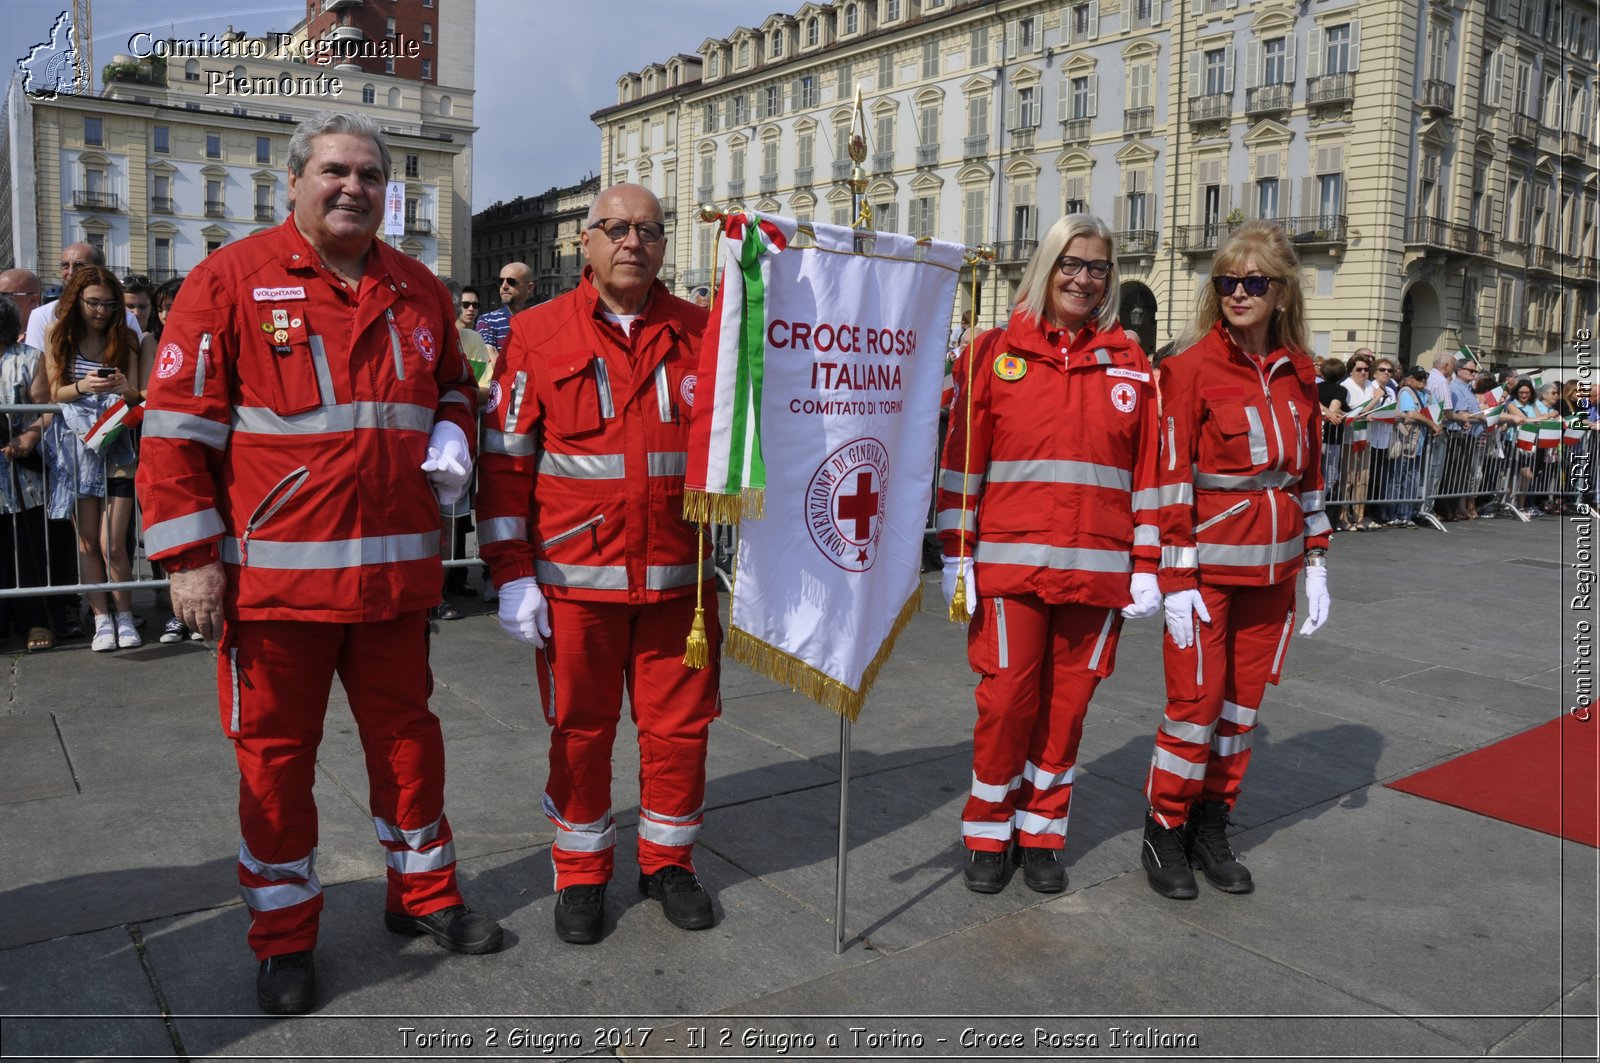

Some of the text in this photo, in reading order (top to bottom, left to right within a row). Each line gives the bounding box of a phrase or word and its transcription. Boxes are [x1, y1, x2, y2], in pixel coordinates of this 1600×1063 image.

[767, 319, 917, 356] CROCE ROSSA
[811, 362, 902, 391] ITALIANA
[1113, 370, 1142, 379] VOLONTARIO
[789, 399, 903, 415] COMITATO DI TORIN
[810, 469, 847, 558] CONVENZIONE
[832, 454, 849, 474] DI
[848, 443, 883, 468] GINEVRA
